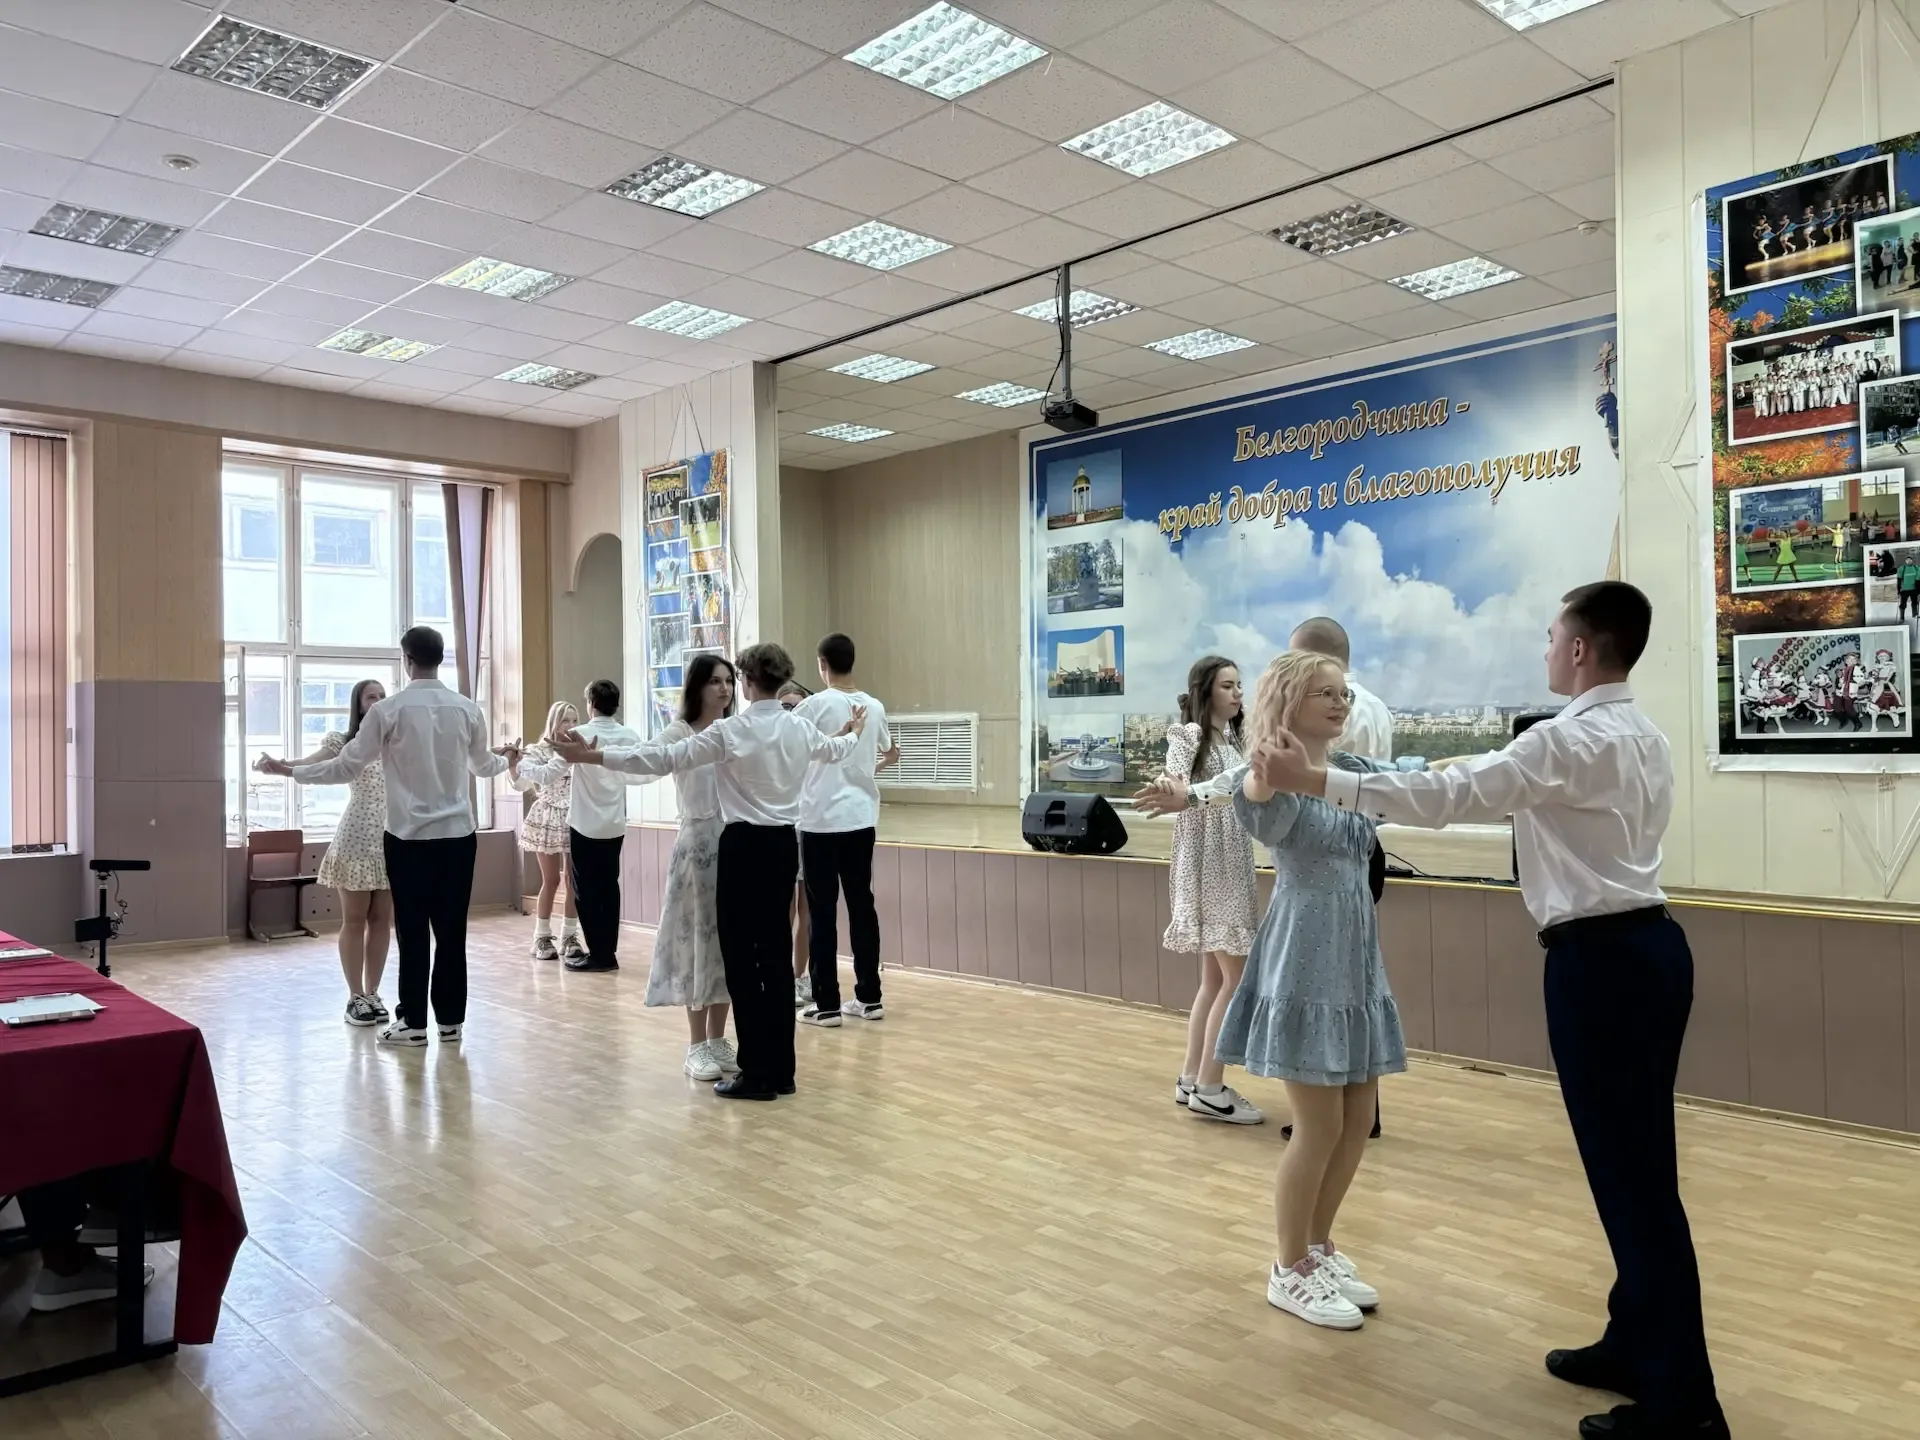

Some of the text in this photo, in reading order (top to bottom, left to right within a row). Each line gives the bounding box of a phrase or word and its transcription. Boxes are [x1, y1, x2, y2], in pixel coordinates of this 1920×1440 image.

[1234, 397, 1448, 461] Белгородчина
[1158, 445, 1580, 542] край добра и благополучия
